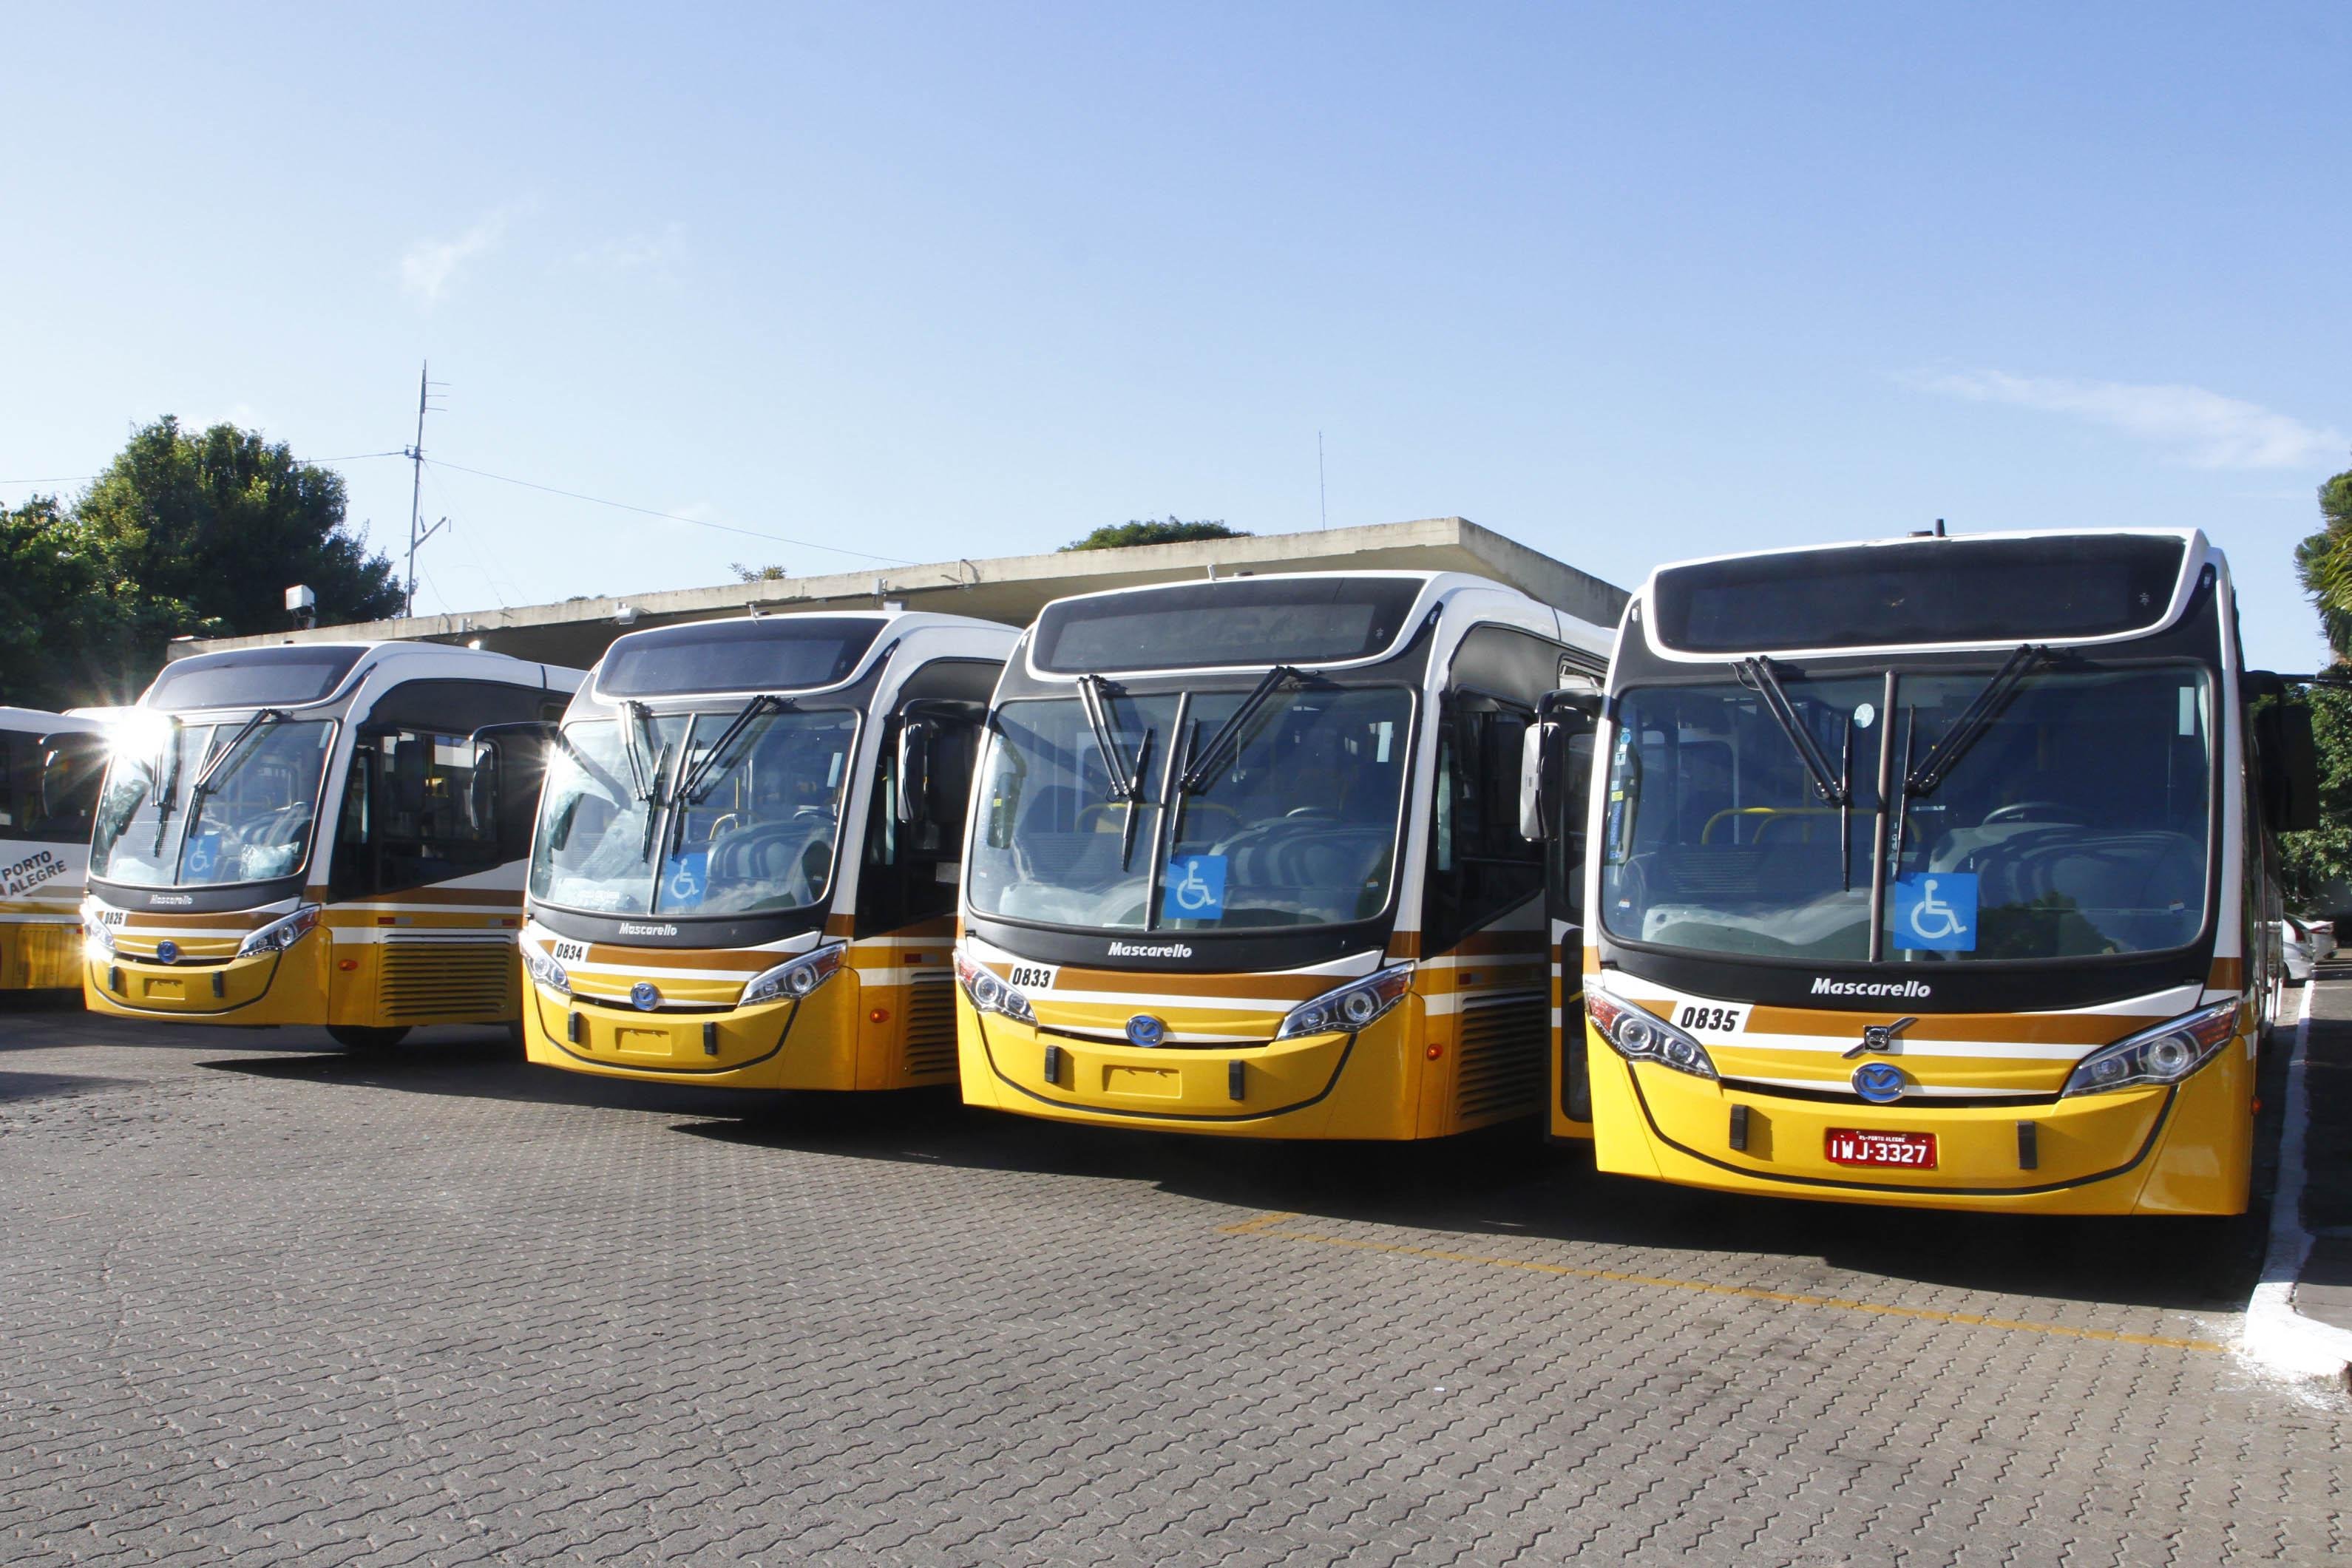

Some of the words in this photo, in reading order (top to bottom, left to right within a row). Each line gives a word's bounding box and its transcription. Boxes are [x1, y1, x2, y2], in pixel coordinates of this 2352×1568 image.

[1, 851, 52, 881] PORTO
[10, 860, 67, 896] ALEGRE
[149, 895, 193, 905] Mascarello
[619, 922, 677, 936] Mascarello
[556, 943, 583, 961] 0834
[1108, 942, 1192, 957] Mascarello
[1012, 967, 1051, 988] 0833
[1811, 977, 1931, 997] Mascarello
[1681, 1006, 1740, 1032] 0835
[1832, 1140, 1927, 1164] IWJ-3327
